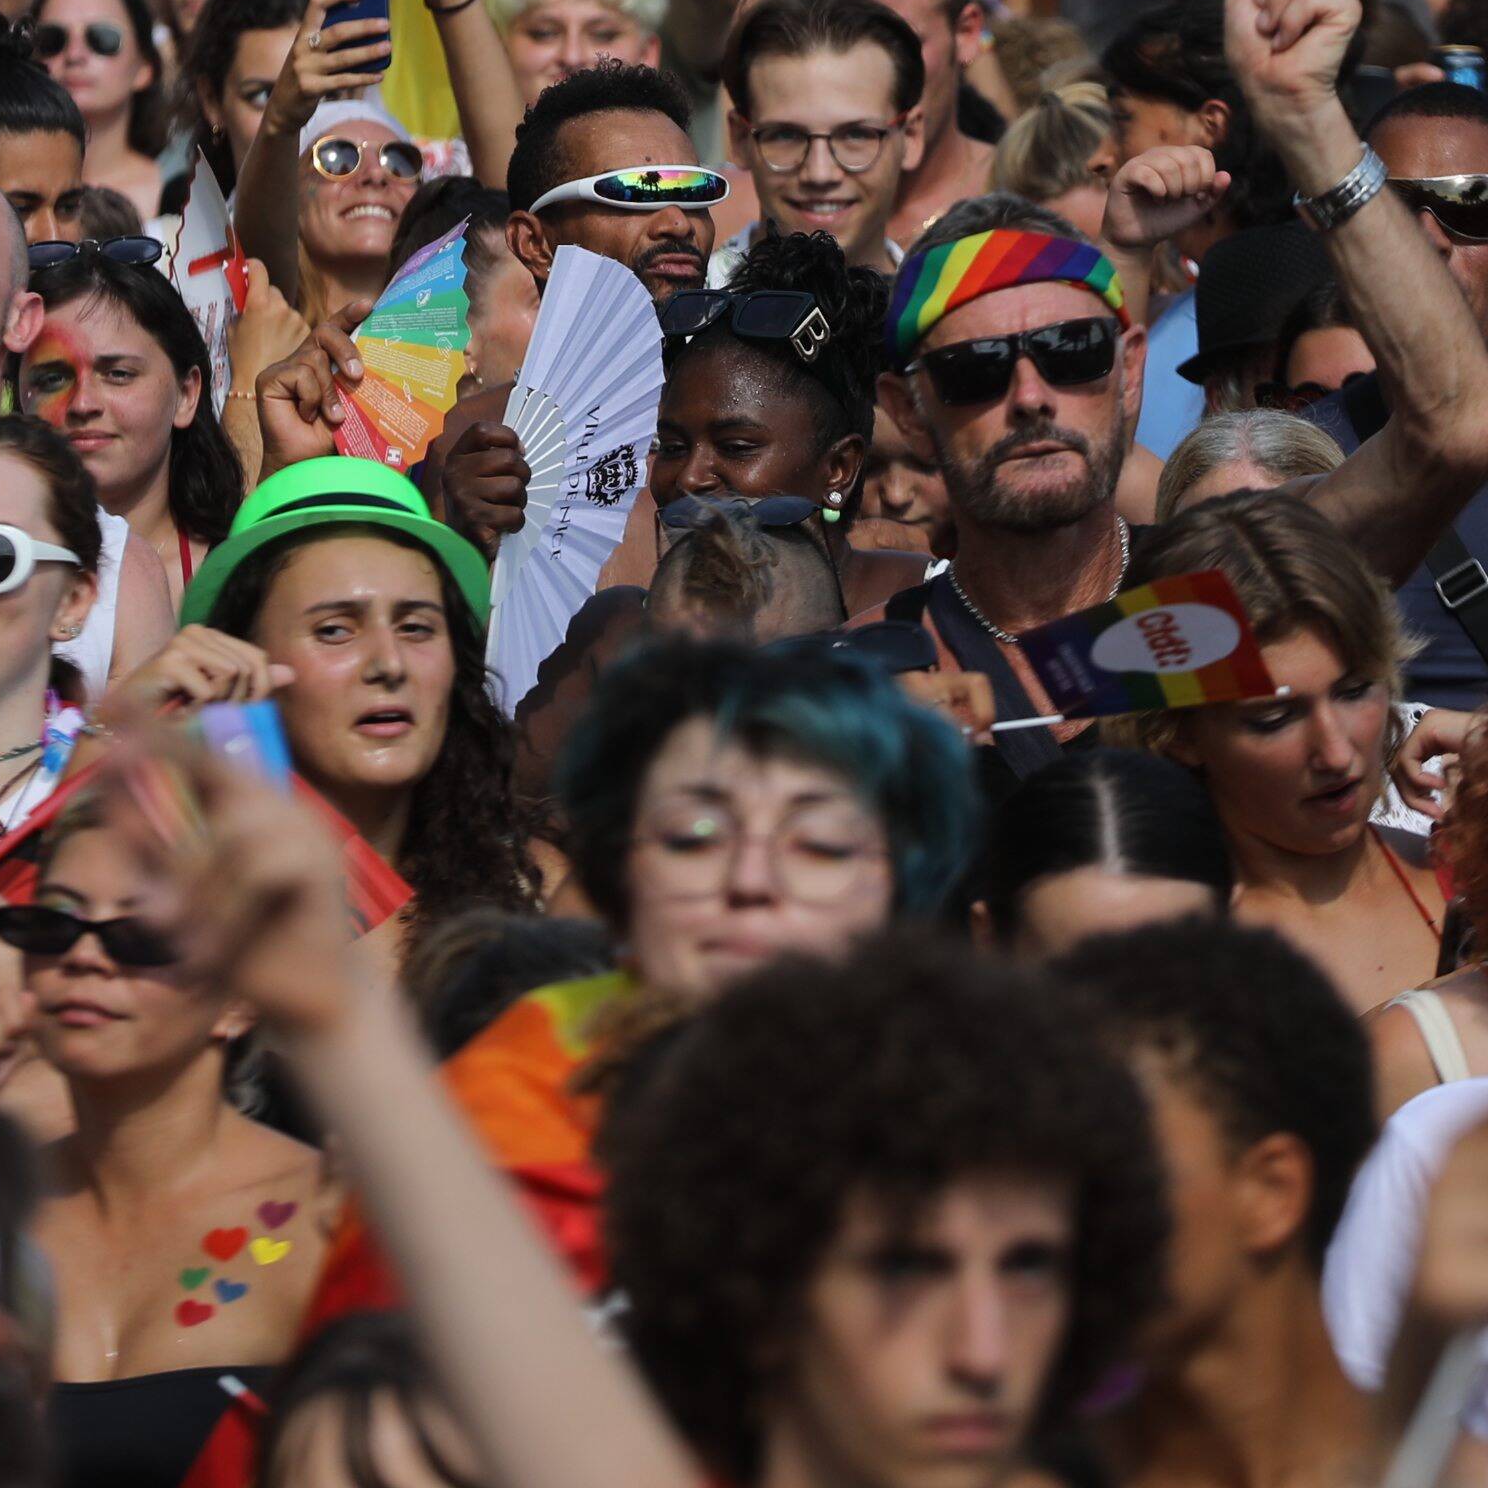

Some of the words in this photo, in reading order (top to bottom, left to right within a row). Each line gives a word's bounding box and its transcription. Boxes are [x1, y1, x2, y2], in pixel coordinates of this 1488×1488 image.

[575, 404, 601, 462] VILLE
[564, 472, 581, 502] DE
[549, 505, 572, 562] NICE
